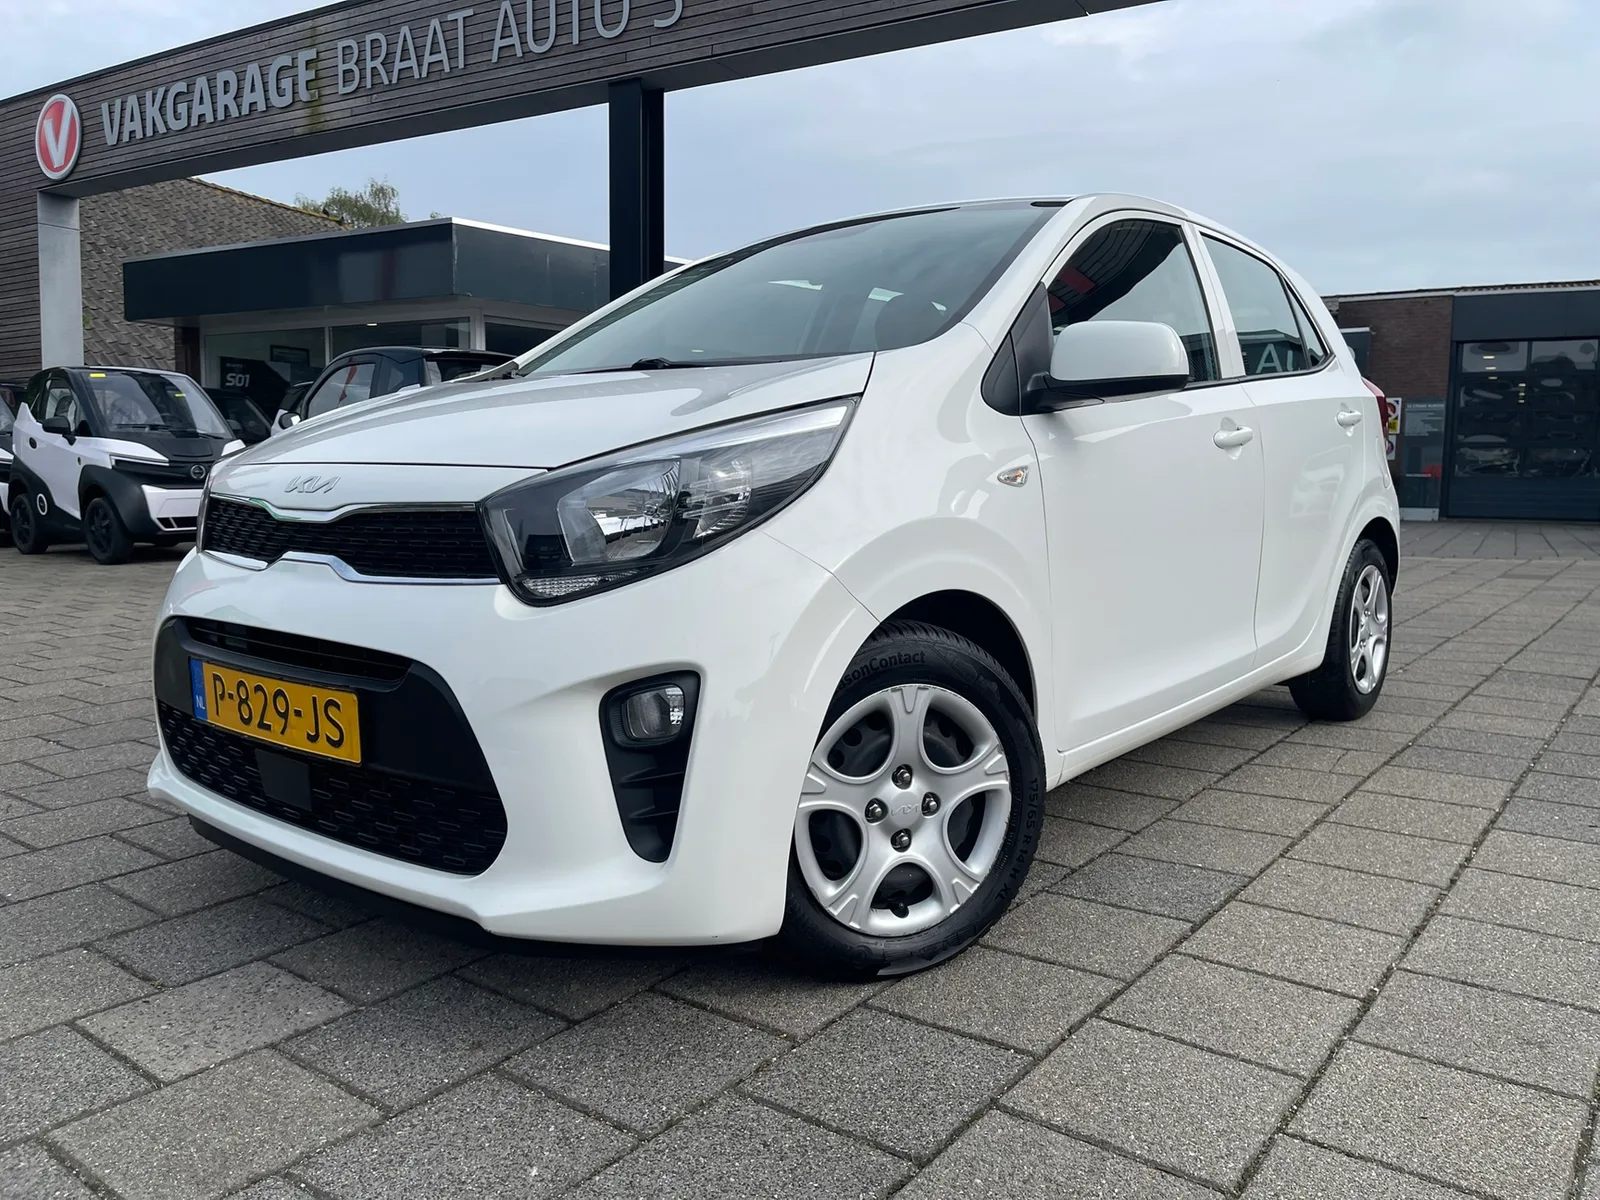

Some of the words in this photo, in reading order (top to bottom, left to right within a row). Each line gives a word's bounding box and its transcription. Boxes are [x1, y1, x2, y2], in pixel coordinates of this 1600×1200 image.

[101, 47, 318, 146] VAKGARAGE
[337, 8, 474, 95] BRAAT
[212, 671, 345, 748] P-829-JS
